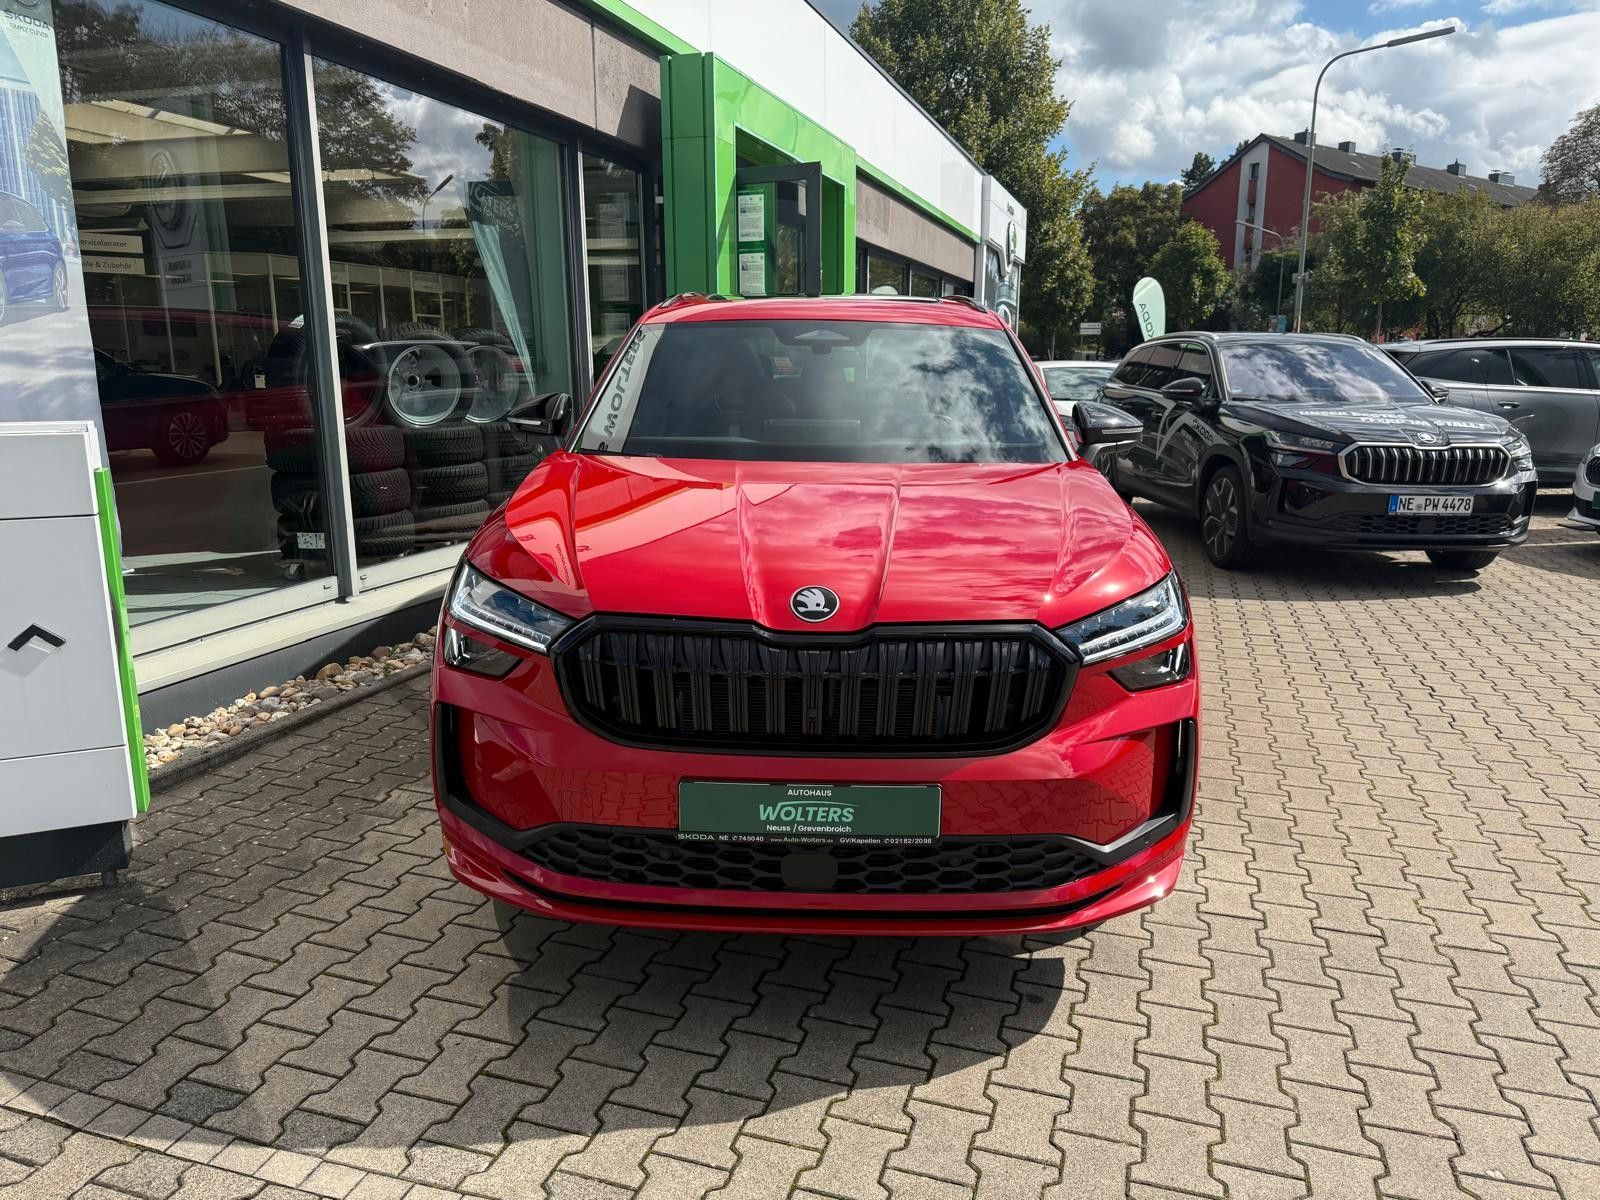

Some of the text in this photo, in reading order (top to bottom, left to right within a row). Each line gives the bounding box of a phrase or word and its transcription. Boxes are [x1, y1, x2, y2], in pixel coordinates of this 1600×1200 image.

[1399, 497, 1472, 511] NE PW 4478
[787, 789, 832, 797] AUTOHAUS
[759, 801, 855, 823] WOLTERS
[766, 824, 791, 832] Neuss
